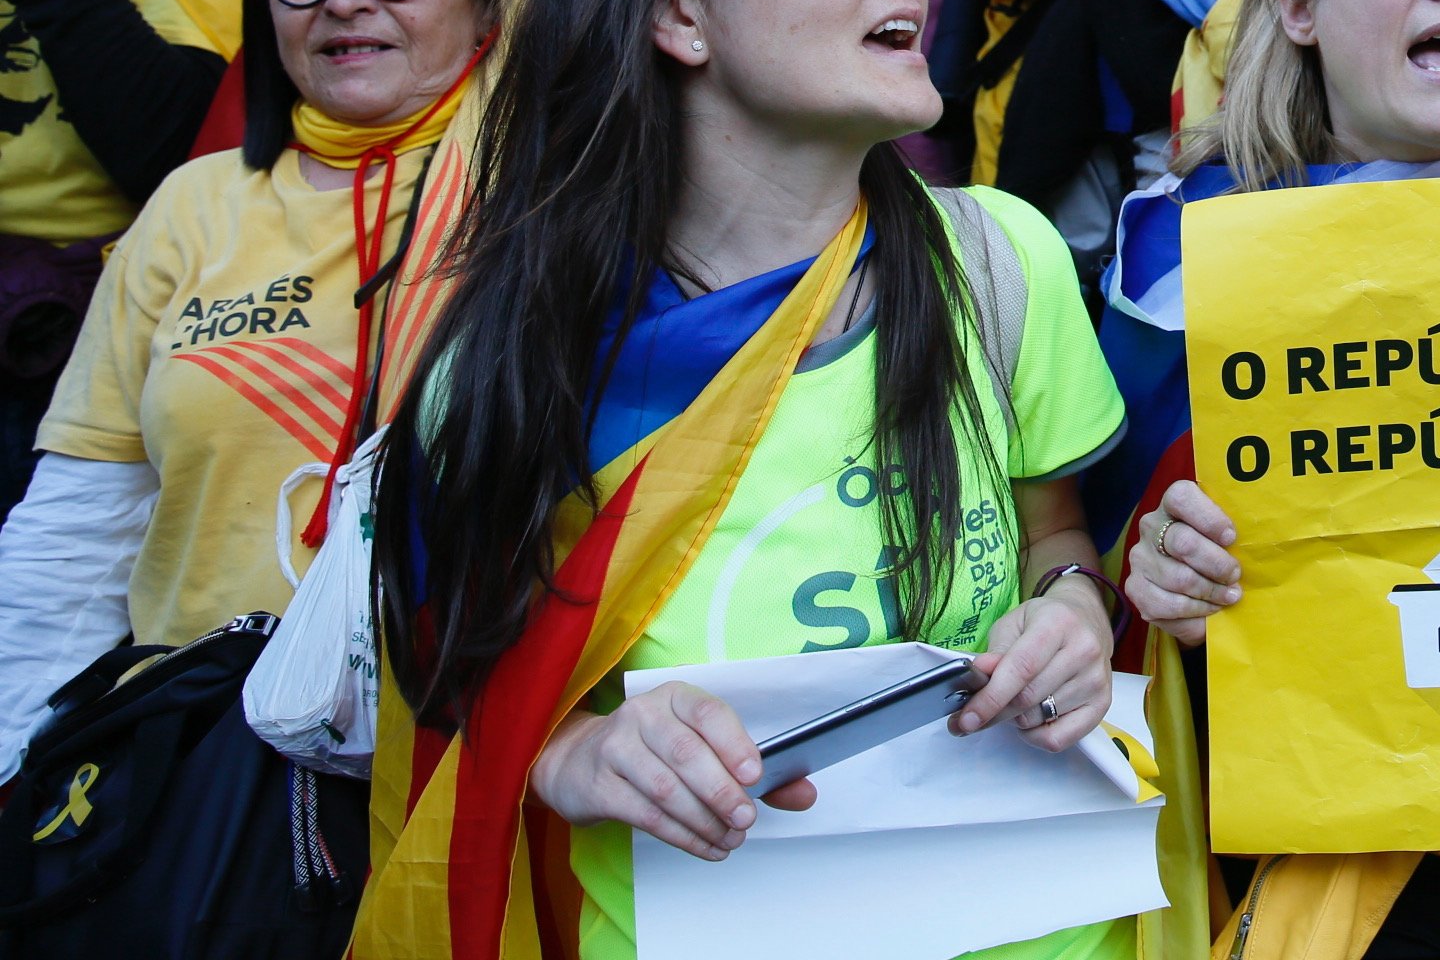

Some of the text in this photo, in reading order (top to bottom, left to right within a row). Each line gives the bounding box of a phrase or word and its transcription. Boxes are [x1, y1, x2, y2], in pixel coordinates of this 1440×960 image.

[178, 273, 315, 322] ARA ÉS
[1220, 351, 1267, 400] O
[1226, 435, 1271, 483] O
[964, 522, 1005, 563] Oui
[970, 561, 995, 582] Da
